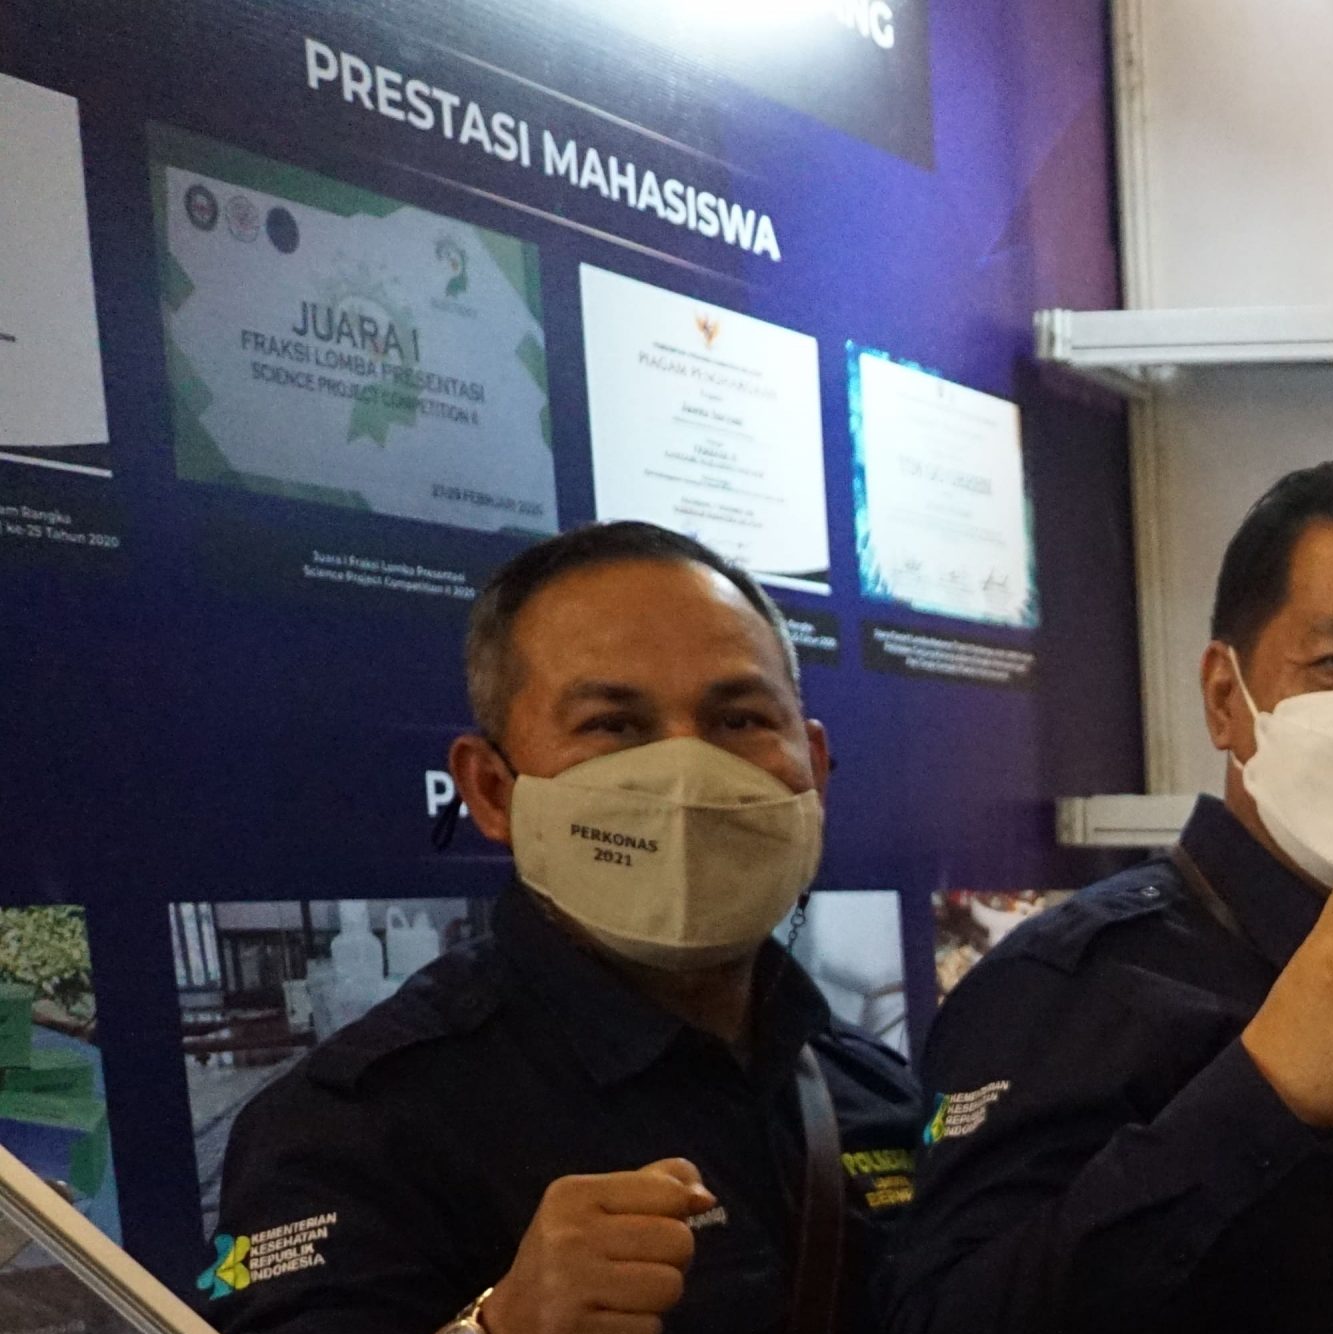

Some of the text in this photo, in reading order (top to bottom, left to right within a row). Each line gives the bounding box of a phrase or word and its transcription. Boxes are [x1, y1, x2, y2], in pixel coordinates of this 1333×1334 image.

[305, 38, 781, 262] PRESTASI MAHASISWA
[292, 300, 403, 355] JUARA
[241, 329, 311, 364] FRAKSI
[315, 348, 377, 378] LOMBA
[88, 532, 120, 549] 2020
[571, 823, 658, 853] PERKONAS
[594, 847, 632, 868] 2021
[250, 1211, 337, 1245] KEMENTERIAN
[250, 1226, 328, 1258] KESEHATAN
[249, 1242, 315, 1271] REPUBLIK
[250, 1253, 326, 1282] INDONESIA
